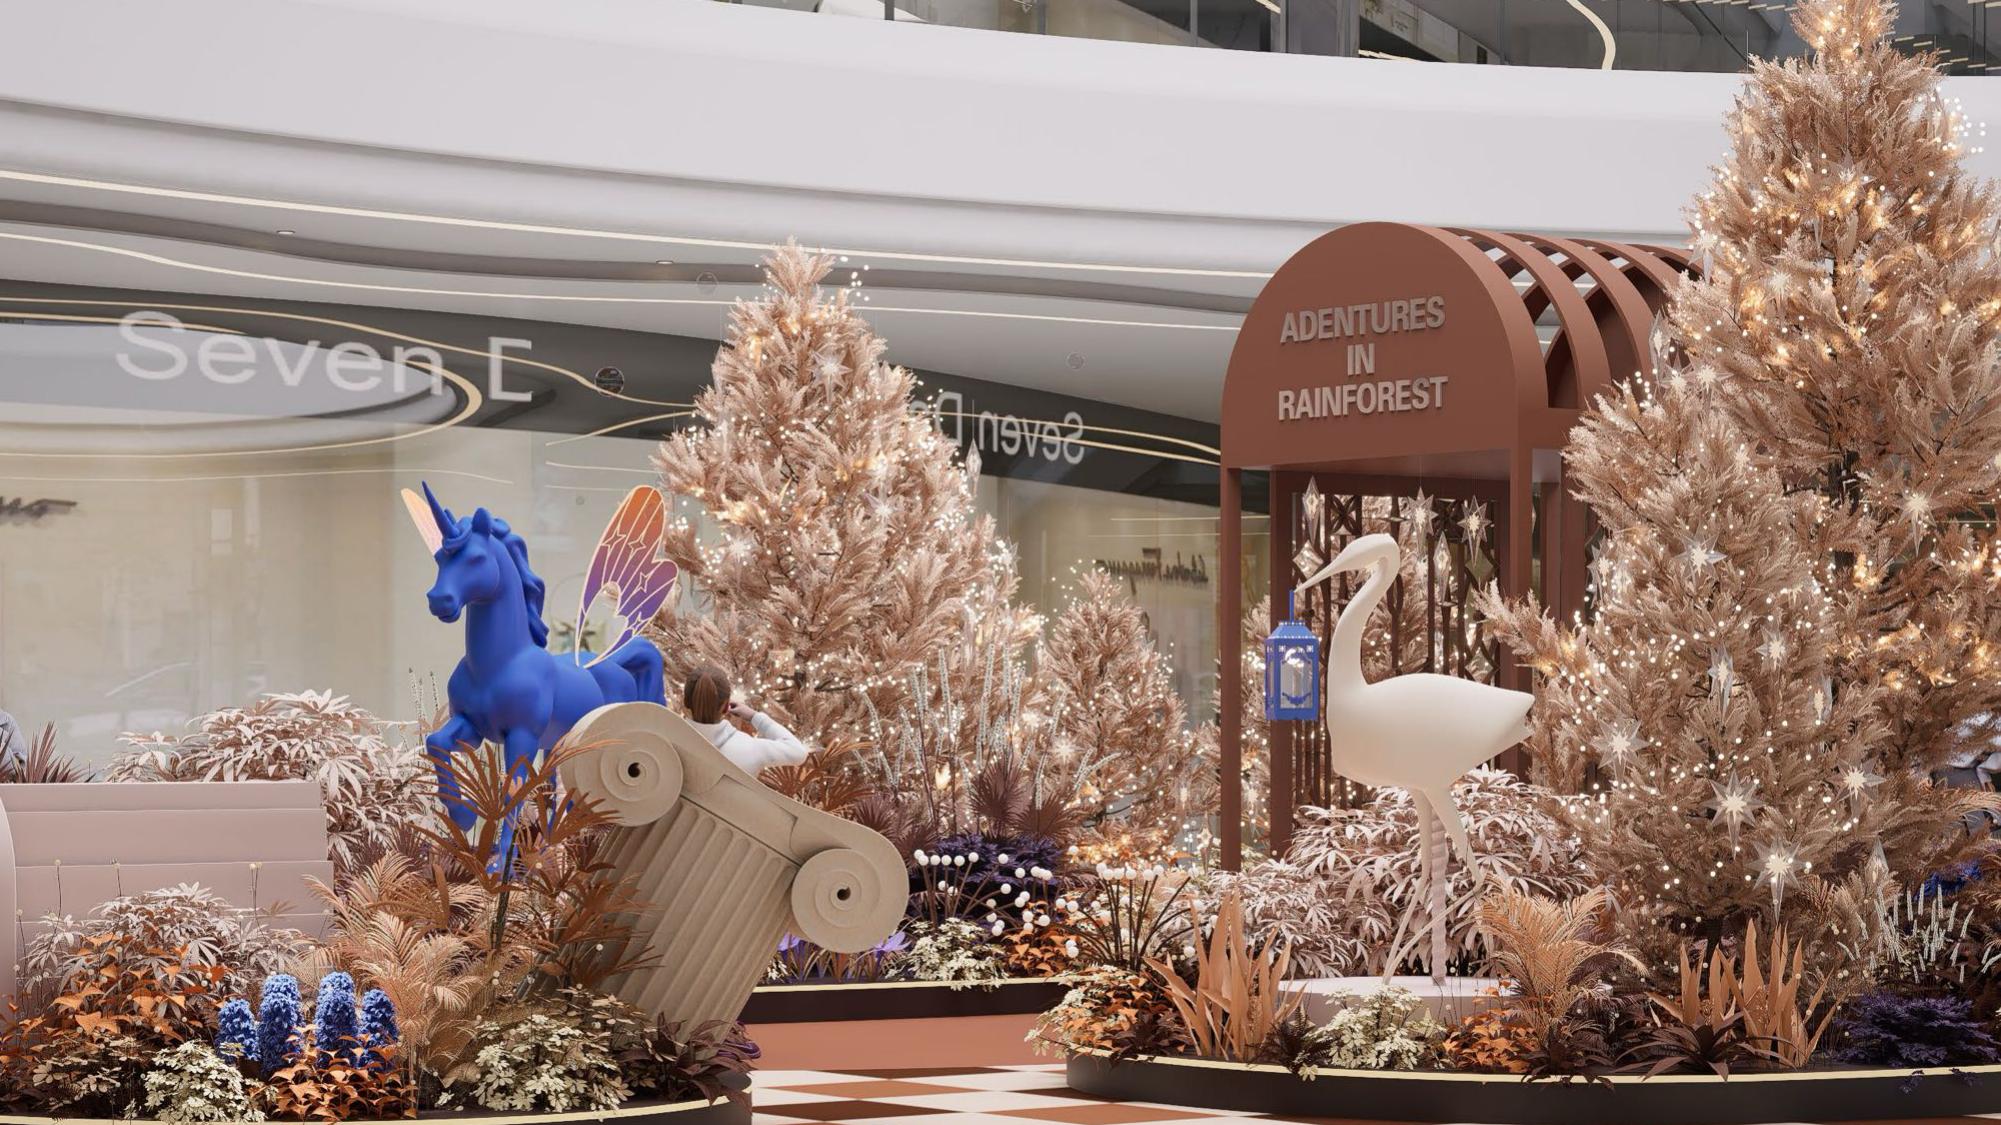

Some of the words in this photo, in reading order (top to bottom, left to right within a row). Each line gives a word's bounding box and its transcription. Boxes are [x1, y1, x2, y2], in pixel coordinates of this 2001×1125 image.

[1280, 296, 1446, 345] ADENTURES
[115, 310, 443, 396] Seven
[1347, 343, 1376, 376] IN
[1278, 376, 1449, 421] RAINFOREST
